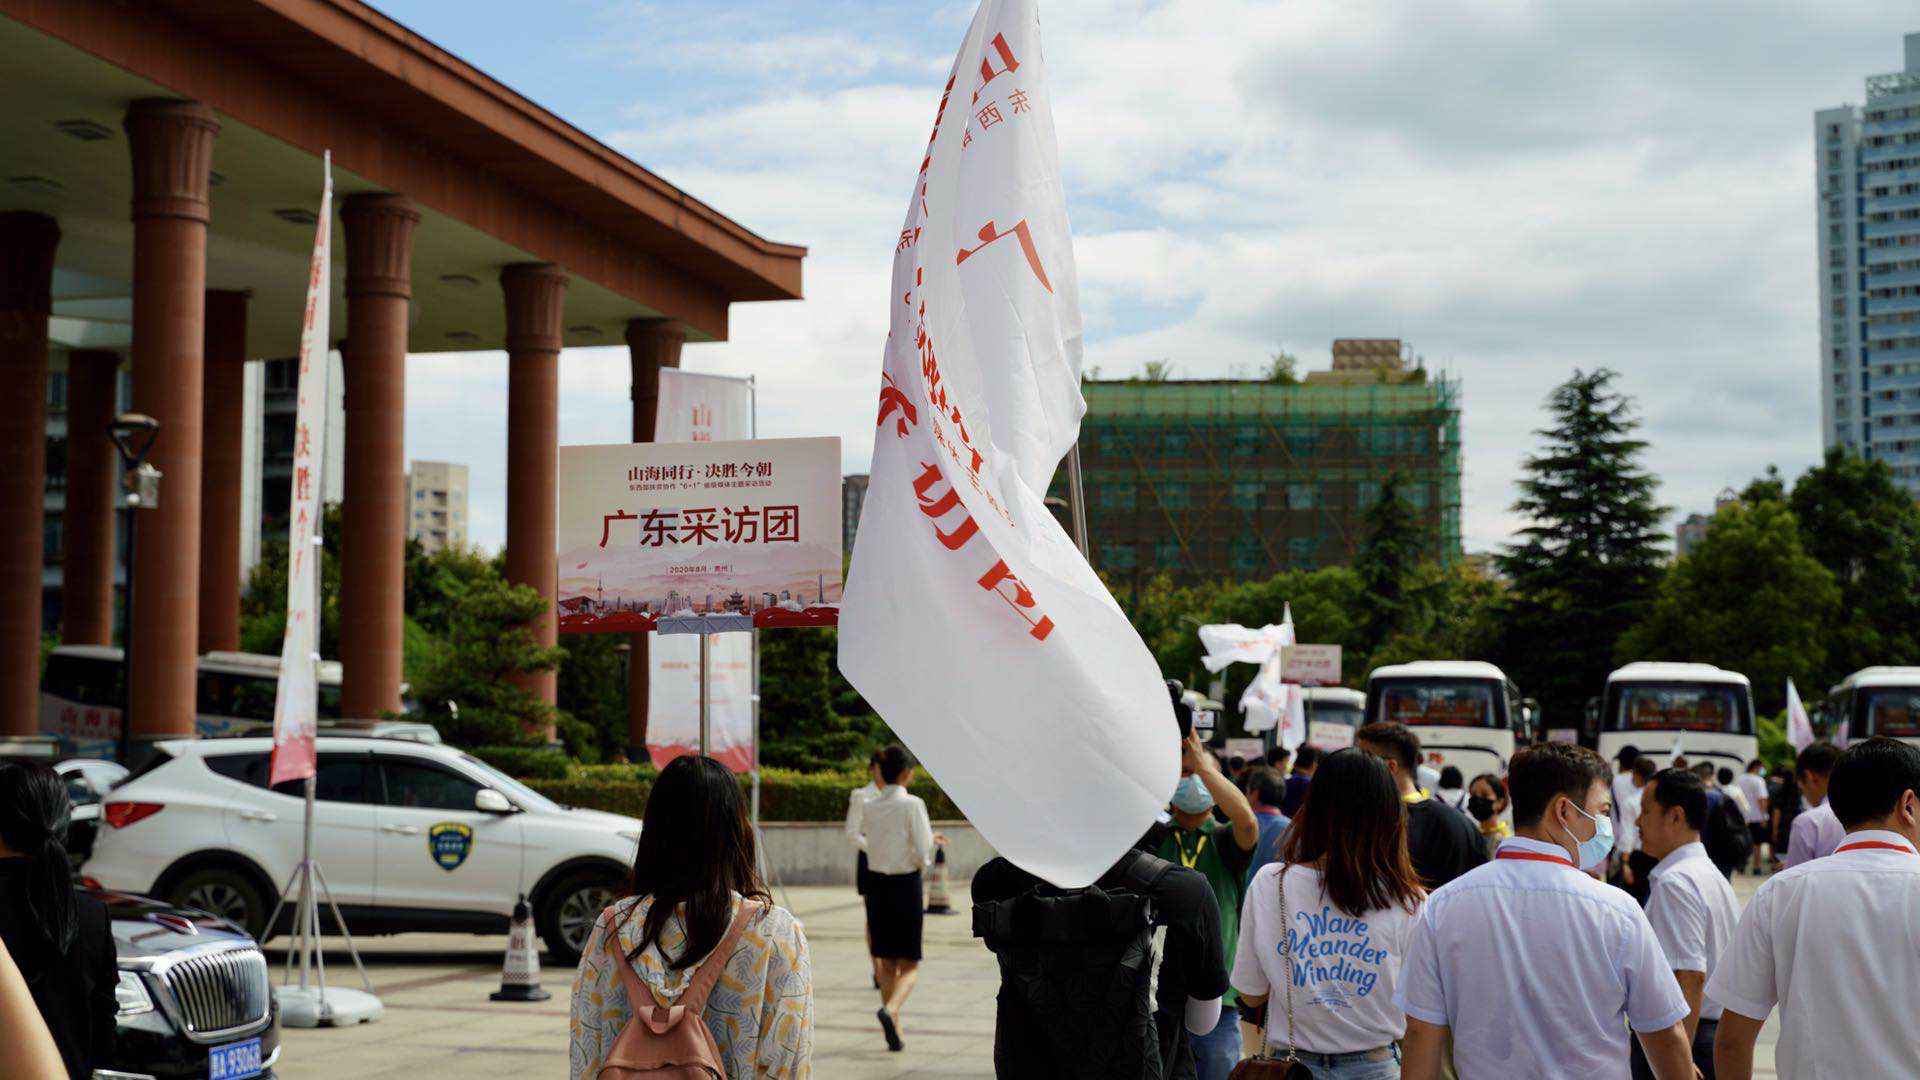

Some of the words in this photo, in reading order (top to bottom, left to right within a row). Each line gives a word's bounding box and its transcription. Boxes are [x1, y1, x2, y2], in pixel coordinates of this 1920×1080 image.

[600, 504, 800, 549] 广东采访团
[1296, 905, 1369, 938] Wave
[1277, 928, 1388, 965] Meander
[1286, 956, 1378, 997] Winding
